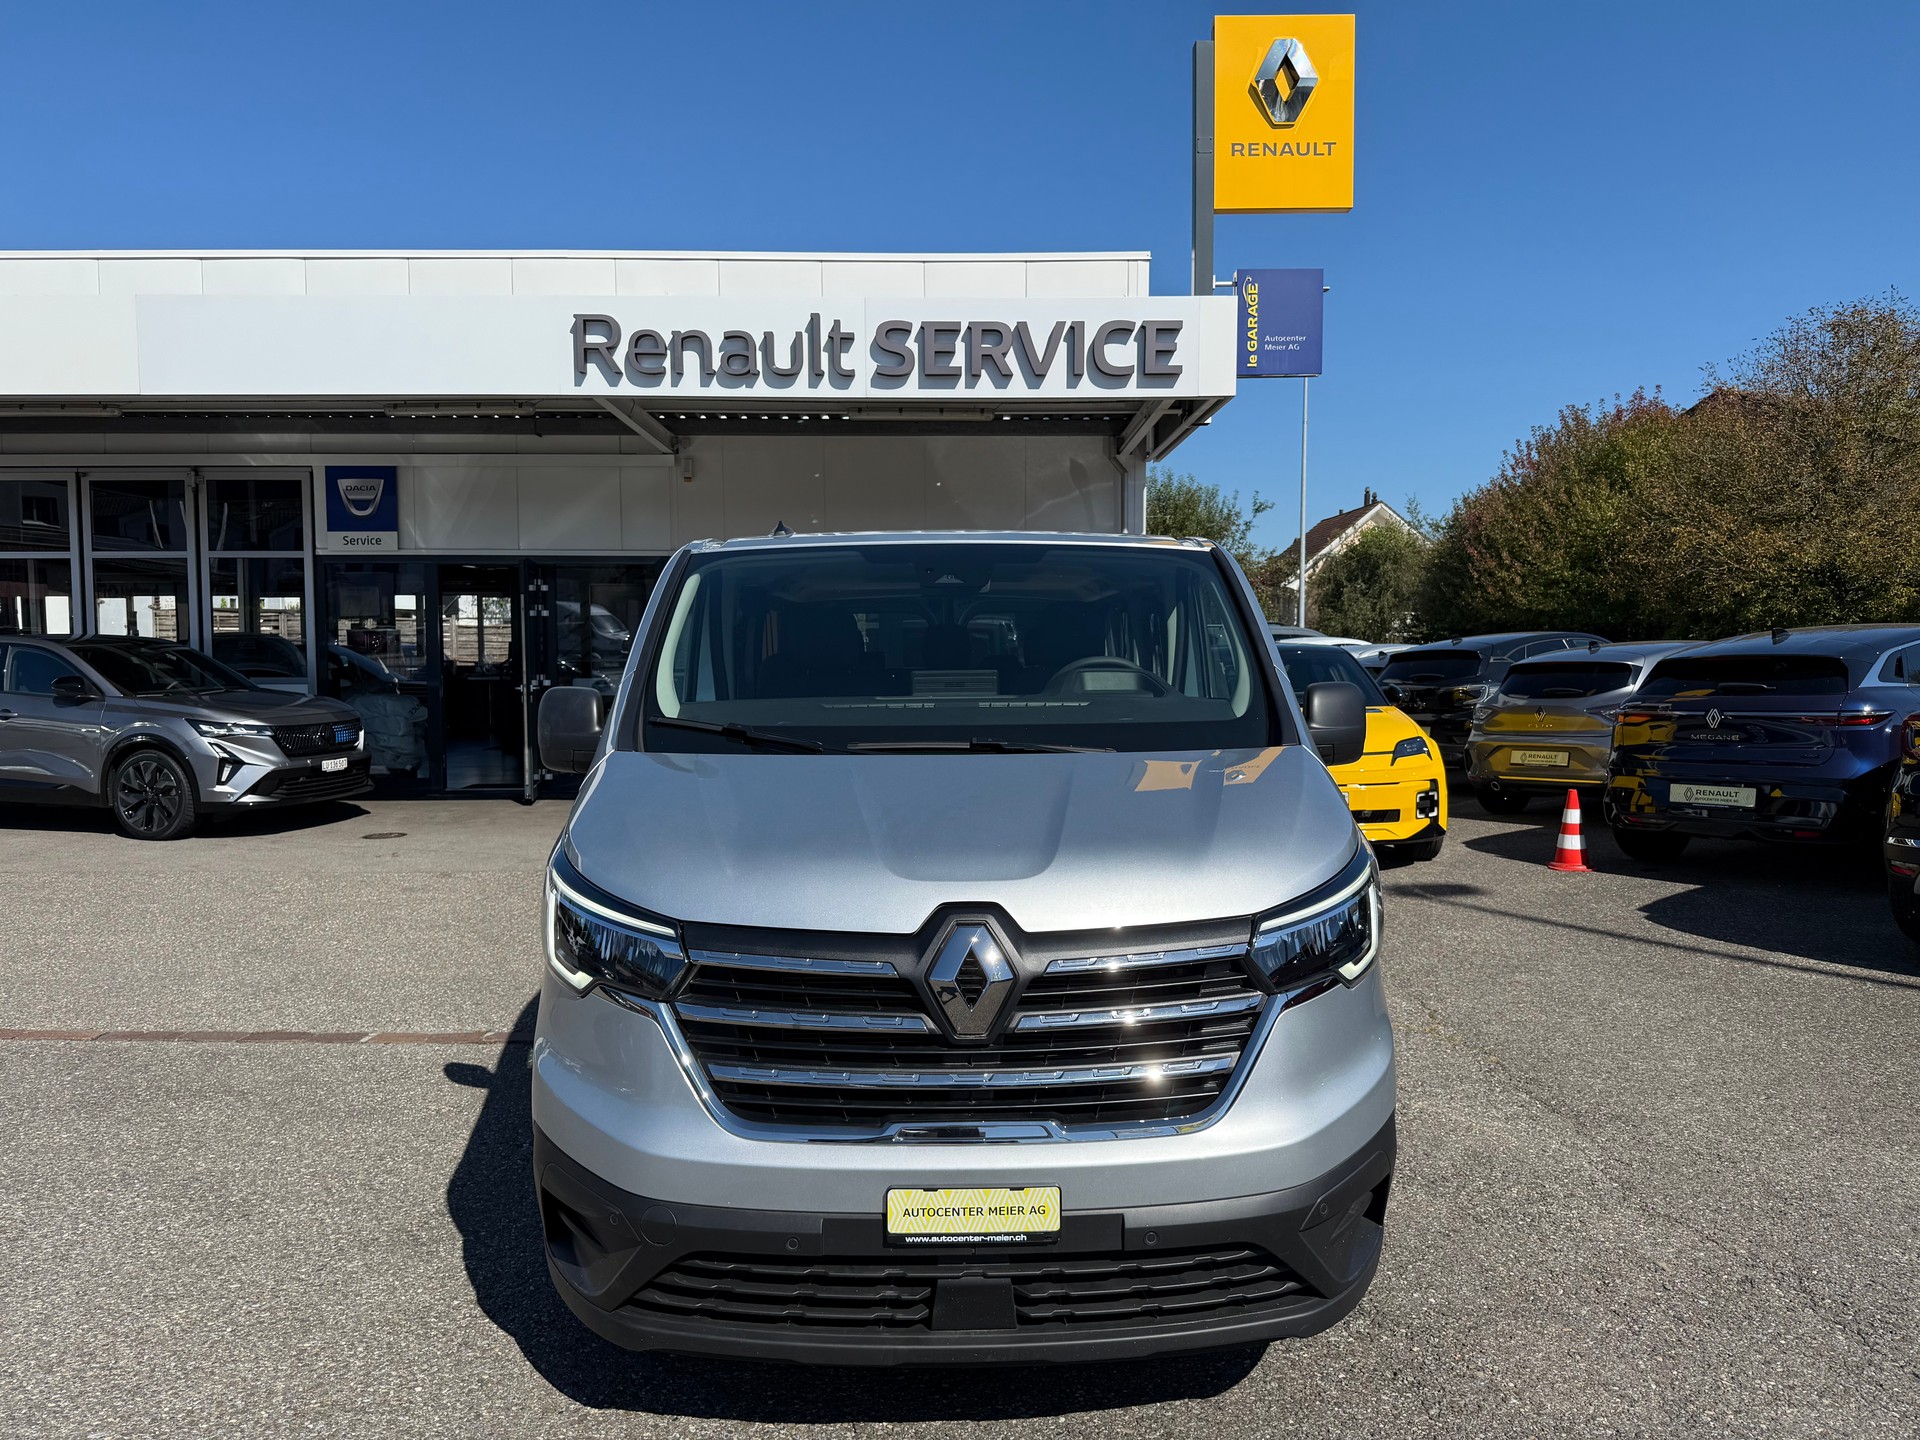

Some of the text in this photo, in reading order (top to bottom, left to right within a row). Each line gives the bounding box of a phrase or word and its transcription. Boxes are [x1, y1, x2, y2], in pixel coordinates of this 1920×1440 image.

[1231, 142, 1337, 157] RENAULT
[1247, 283, 1259, 367] le GARAGE
[572, 313, 1184, 378] Renault SERVICE
[1288, 343, 1300, 351] AG
[342, 535, 382, 546] Service
[1695, 789, 1740, 798] RENAULT
[902, 1205, 1046, 1218] AUTOCENTER MEIER AG
[905, 1234, 1027, 1243] www.autocenter-meier.ch
